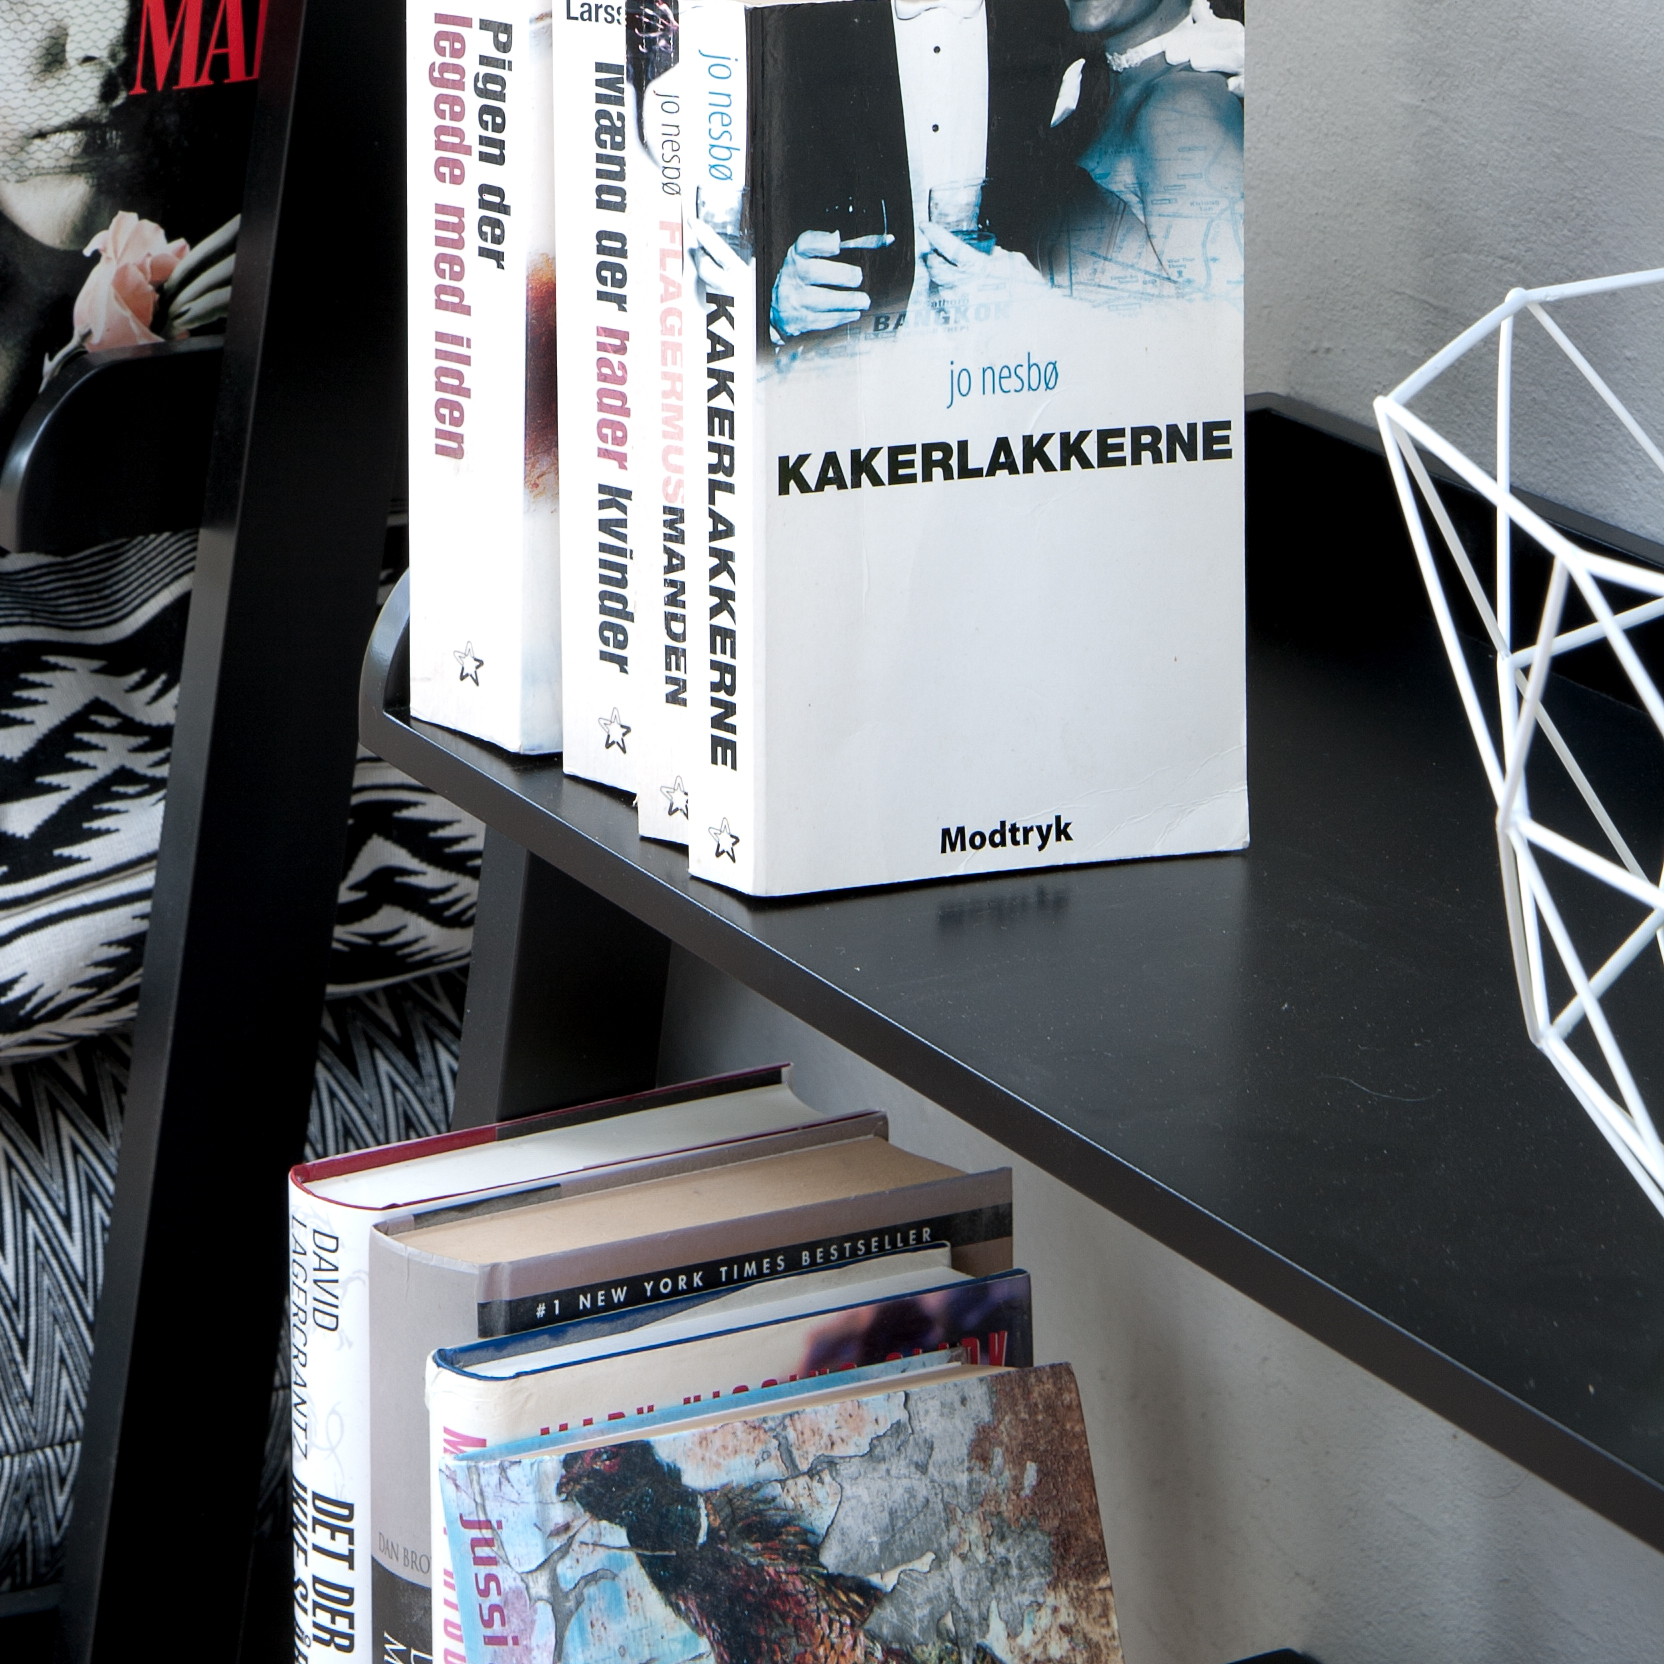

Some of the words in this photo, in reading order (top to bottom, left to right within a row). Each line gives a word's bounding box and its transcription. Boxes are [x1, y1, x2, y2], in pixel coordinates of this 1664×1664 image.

[428, 12, 473, 186] legede
[473, 17, 513, 167] Pigen
[652, 88, 681, 115] jo
[697, 48, 741, 81] jo
[660, 122, 682, 197] nesbø
[707, 90, 741, 182] nesbø
[433, 202, 473, 317] med
[477, 181, 512, 271] der
[595, 228, 629, 314] der
[433, 329, 472, 462] ilden
[596, 325, 631, 471] hader
[946, 360, 973, 409] jo
[981, 351, 1060, 397] nesbø
[777, 419, 1234, 497] KAKERLAKKERNE
[705, 290, 739, 773] KAKERLAKKERNE
[597, 481, 636, 675] kvinder
[940, 814, 1074, 855] Modtryk
[312, 1227, 340, 1333] DAVID
[535, 1298, 562, 1319] #1
[578, 1285, 628, 1311] NEW
[643, 1270, 704, 1298] YORK
[720, 1255, 786, 1282] TIMES
[801, 1226, 933, 1267] BESTSELLER
[291, 1213, 308, 1461] LAGERCRANTZ
[311, 1489, 355, 1572] DET
[378, 1530, 400, 1563] DAN
[403, 1546, 432, 1576] BRO
[311, 1573, 355, 1655] DER
[458, 1512, 521, 1648] jussi
